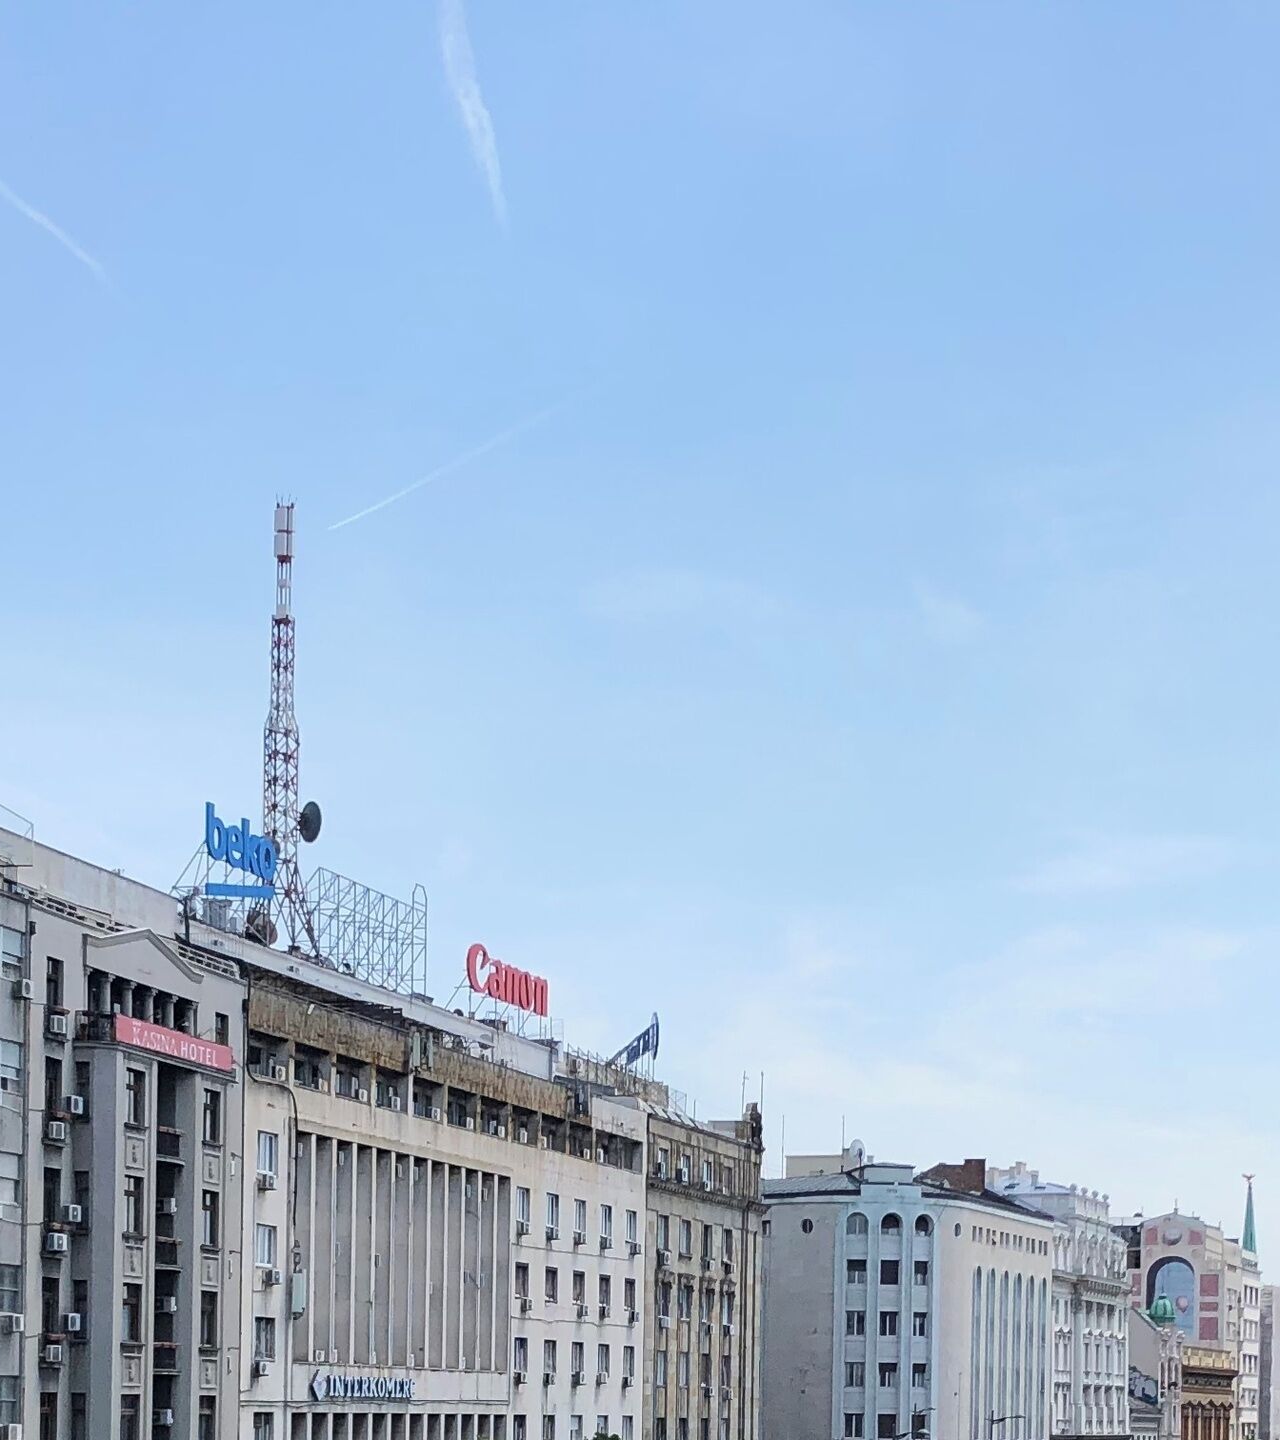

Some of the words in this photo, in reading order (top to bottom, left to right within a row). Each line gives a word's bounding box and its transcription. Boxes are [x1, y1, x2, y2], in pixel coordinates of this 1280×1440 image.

[205, 802, 277, 883] beko
[466, 943, 549, 1017] Canon
[132, 1027, 179, 1056] KASINA
[181, 1042, 219, 1067] HOTEL
[329, 1375, 416, 1398] INTERKOMERC
